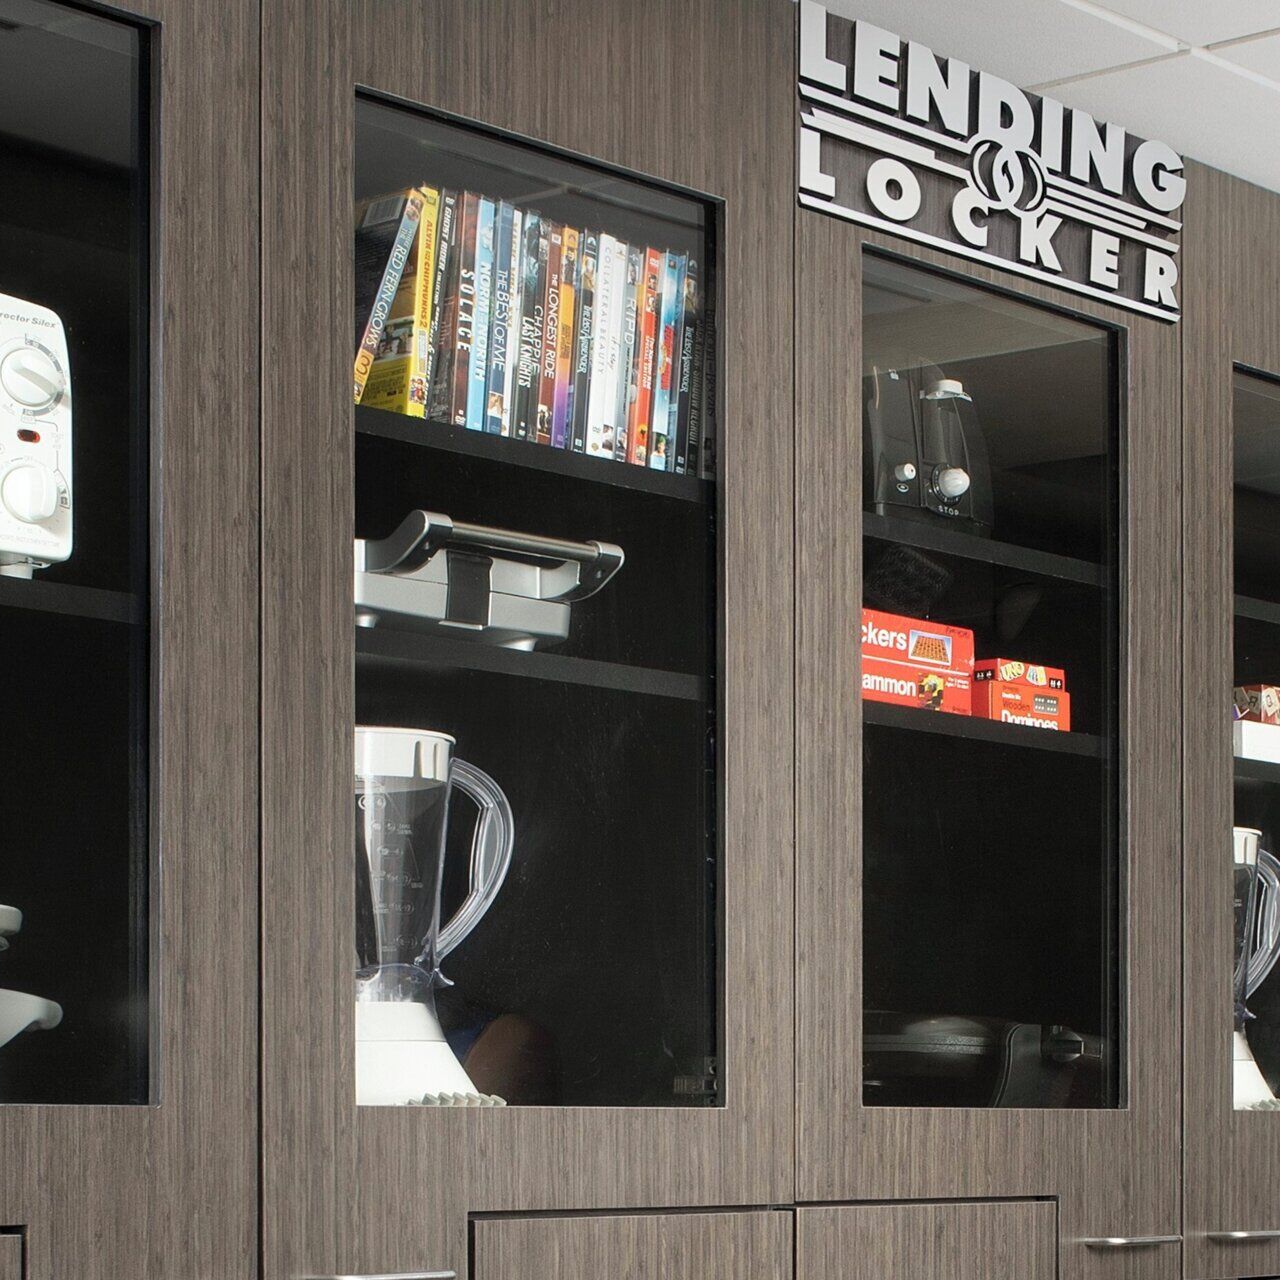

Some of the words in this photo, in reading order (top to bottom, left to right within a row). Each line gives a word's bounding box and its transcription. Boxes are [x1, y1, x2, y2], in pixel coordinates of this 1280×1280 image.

[799, 0, 1187, 213] LENDING
[441, 208, 453, 242] GHOST
[799, 126, 1179, 310] LOCKER
[391, 242, 408, 270] RED
[438, 241, 449, 273] RIDER
[381, 268, 401, 299] FERN
[421, 260, 432, 318] CHIPMUNKS
[478, 261, 493, 310] NORM
[497, 269, 509, 293] THE
[550, 273, 559, 288] THE
[600, 246, 612, 325] COLLATERAL
[32, 317, 56, 328] Silex
[365, 300, 389, 350] GROWS
[419, 317, 428, 330] 2
[457, 268, 475, 352] SOLACE
[494, 293, 510, 329] BEST
[546, 287, 560, 345] LONGEST
[493, 327, 506, 346] OF
[522, 316, 535, 343] LAST
[531, 305, 544, 374] CHAPPIE
[474, 321, 489, 382] NORTH
[492, 345, 506, 373] ME
[517, 344, 532, 389] KNIGHTS
[543, 348, 556, 380] RIDE
[596, 326, 609, 376] BEAUTY
[938, 505, 959, 516] STOP
